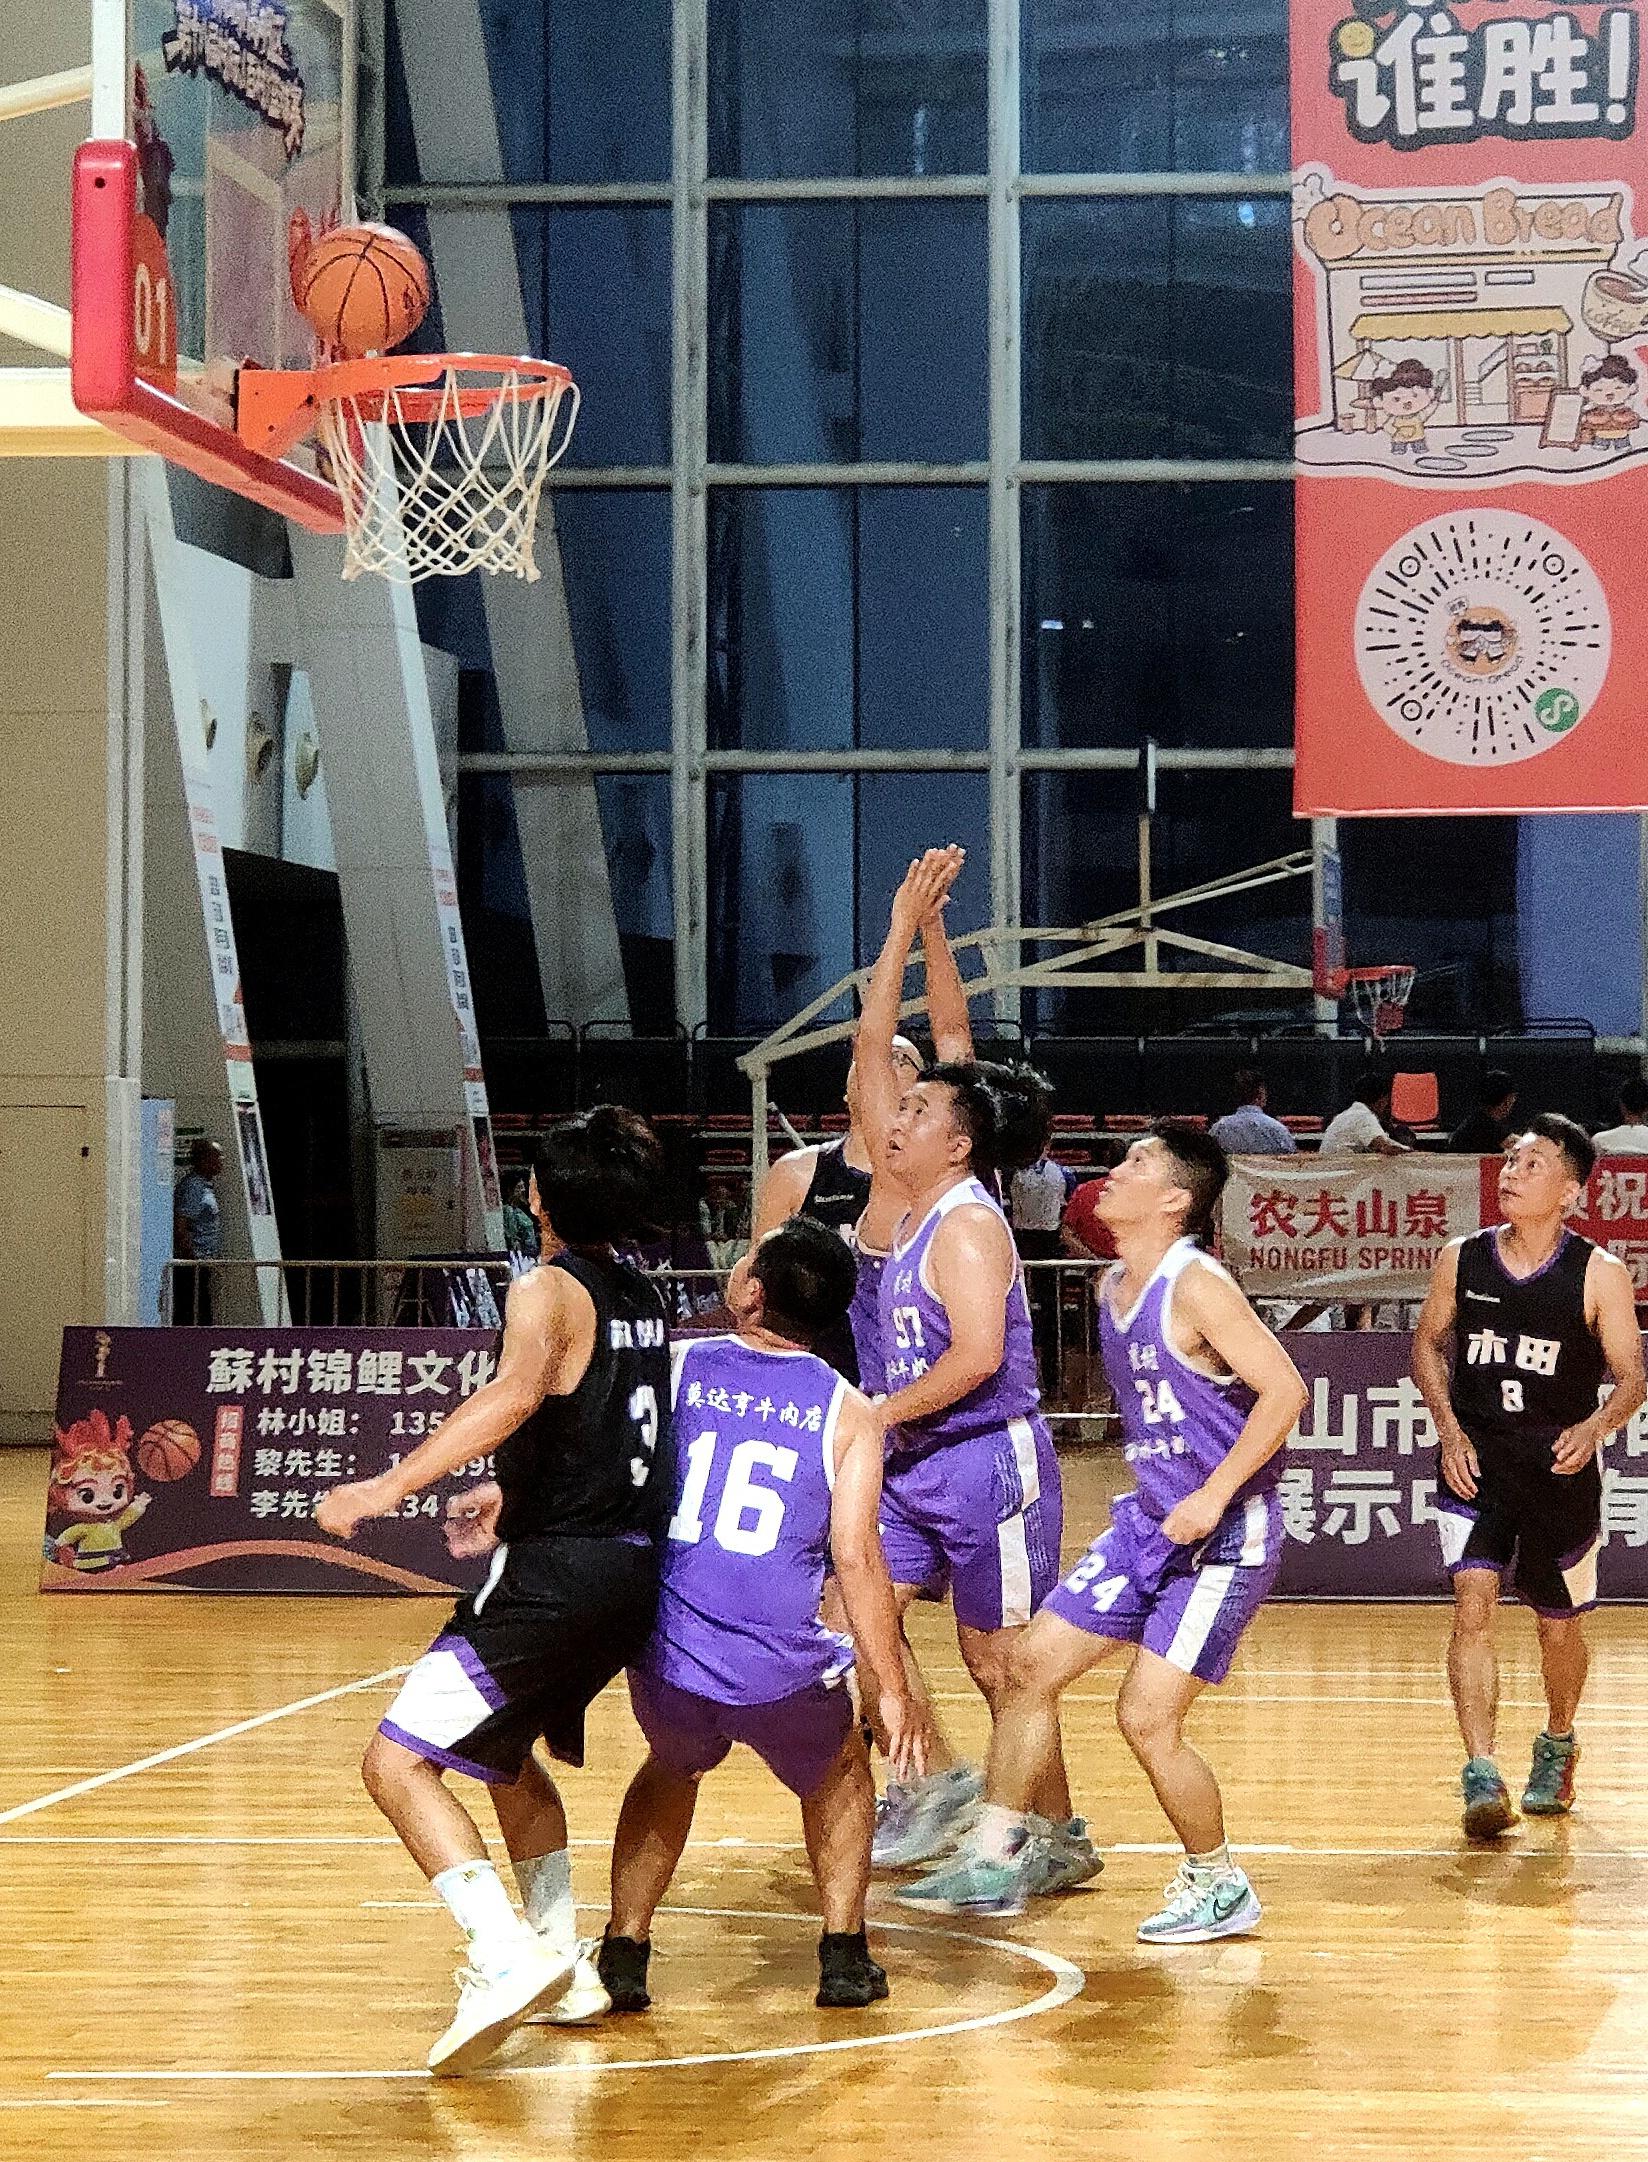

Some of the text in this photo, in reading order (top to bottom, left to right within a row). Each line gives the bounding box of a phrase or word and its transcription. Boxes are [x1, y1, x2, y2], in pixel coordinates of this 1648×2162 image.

[1338, 12, 1630, 135] 谁胜!
[1304, 187, 1624, 260] Ocean Bread
[1250, 1188, 1449, 1239] 农夫山泉
[1251, 1246, 1443, 1271] NONGFU SPRIN
[1466, 1328, 1562, 1376] 木田
[1134, 1379, 1188, 1424] 24
[1500, 1380, 1524, 1412] 8
[256, 1407, 360, 1436] 林小姐：
[253, 1448, 356, 1477] 黎先生：
[667, 1431, 799, 1557] 16
[1064, 1551, 1130, 1613] 24
